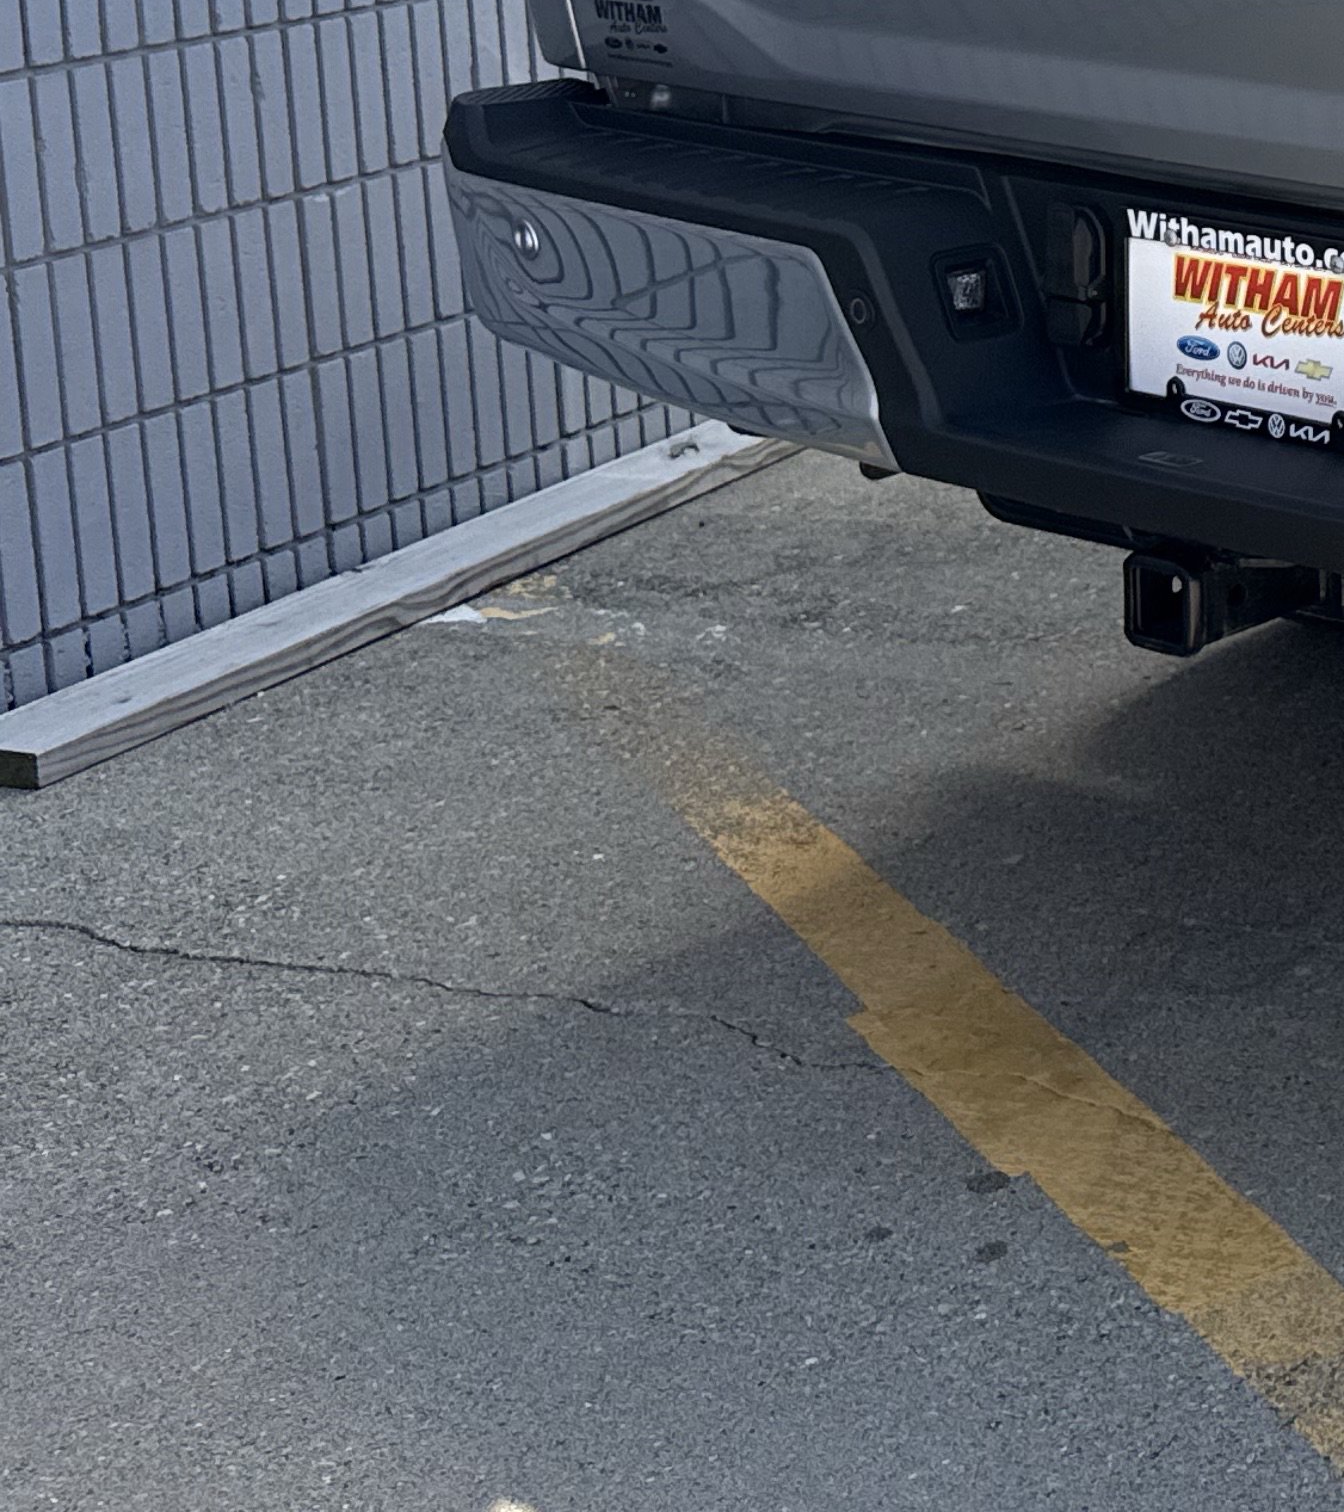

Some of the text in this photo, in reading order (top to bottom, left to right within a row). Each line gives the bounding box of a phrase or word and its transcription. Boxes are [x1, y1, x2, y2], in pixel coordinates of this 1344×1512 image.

[1195, 301, 1252, 331] Auto
[1176, 363, 1226, 387] Everything
[1228, 376, 1242, 388] we
[1243, 376, 1256, 390] do
[1258, 378, 1266, 391] is
[1268, 380, 1300, 399] driven
[1302, 386, 1314, 403] by
